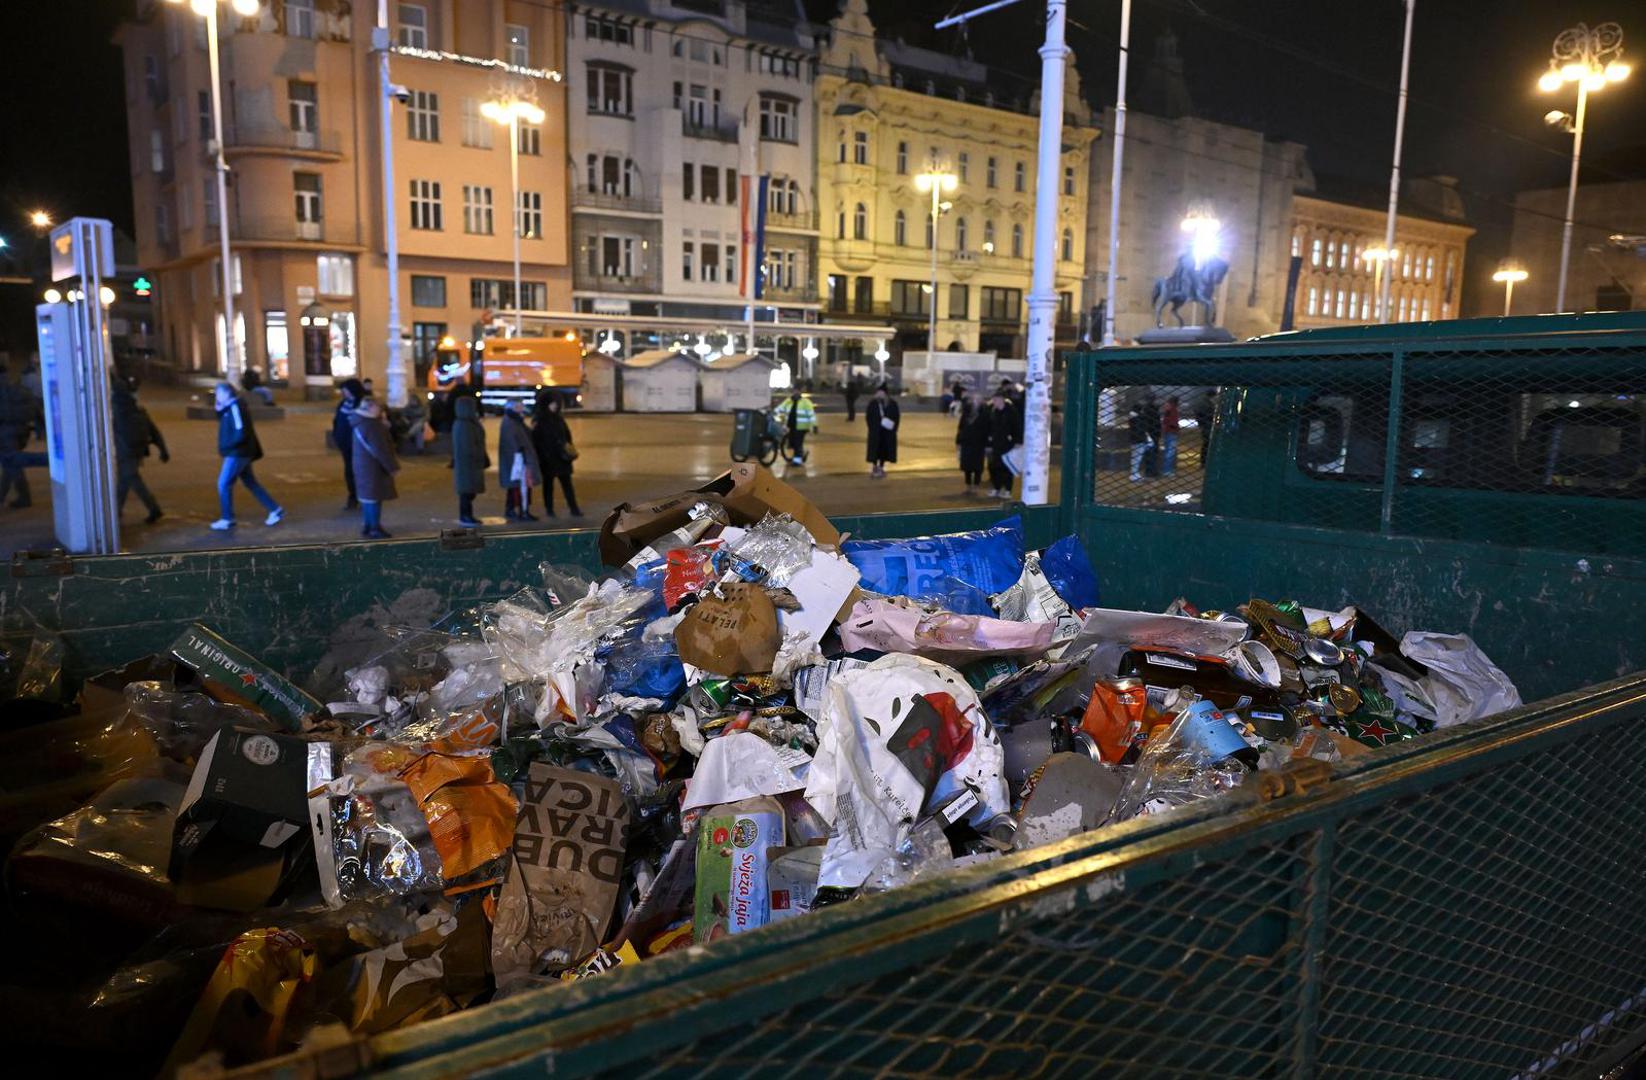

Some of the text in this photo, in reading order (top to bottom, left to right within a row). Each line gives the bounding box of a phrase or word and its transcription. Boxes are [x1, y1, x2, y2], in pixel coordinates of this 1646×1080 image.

[697, 611, 738, 630] PELATI
[188, 634, 240, 675] ORIGINAL
[738, 853, 755, 896] Svježa
[735, 897, 751, 927] jaja
